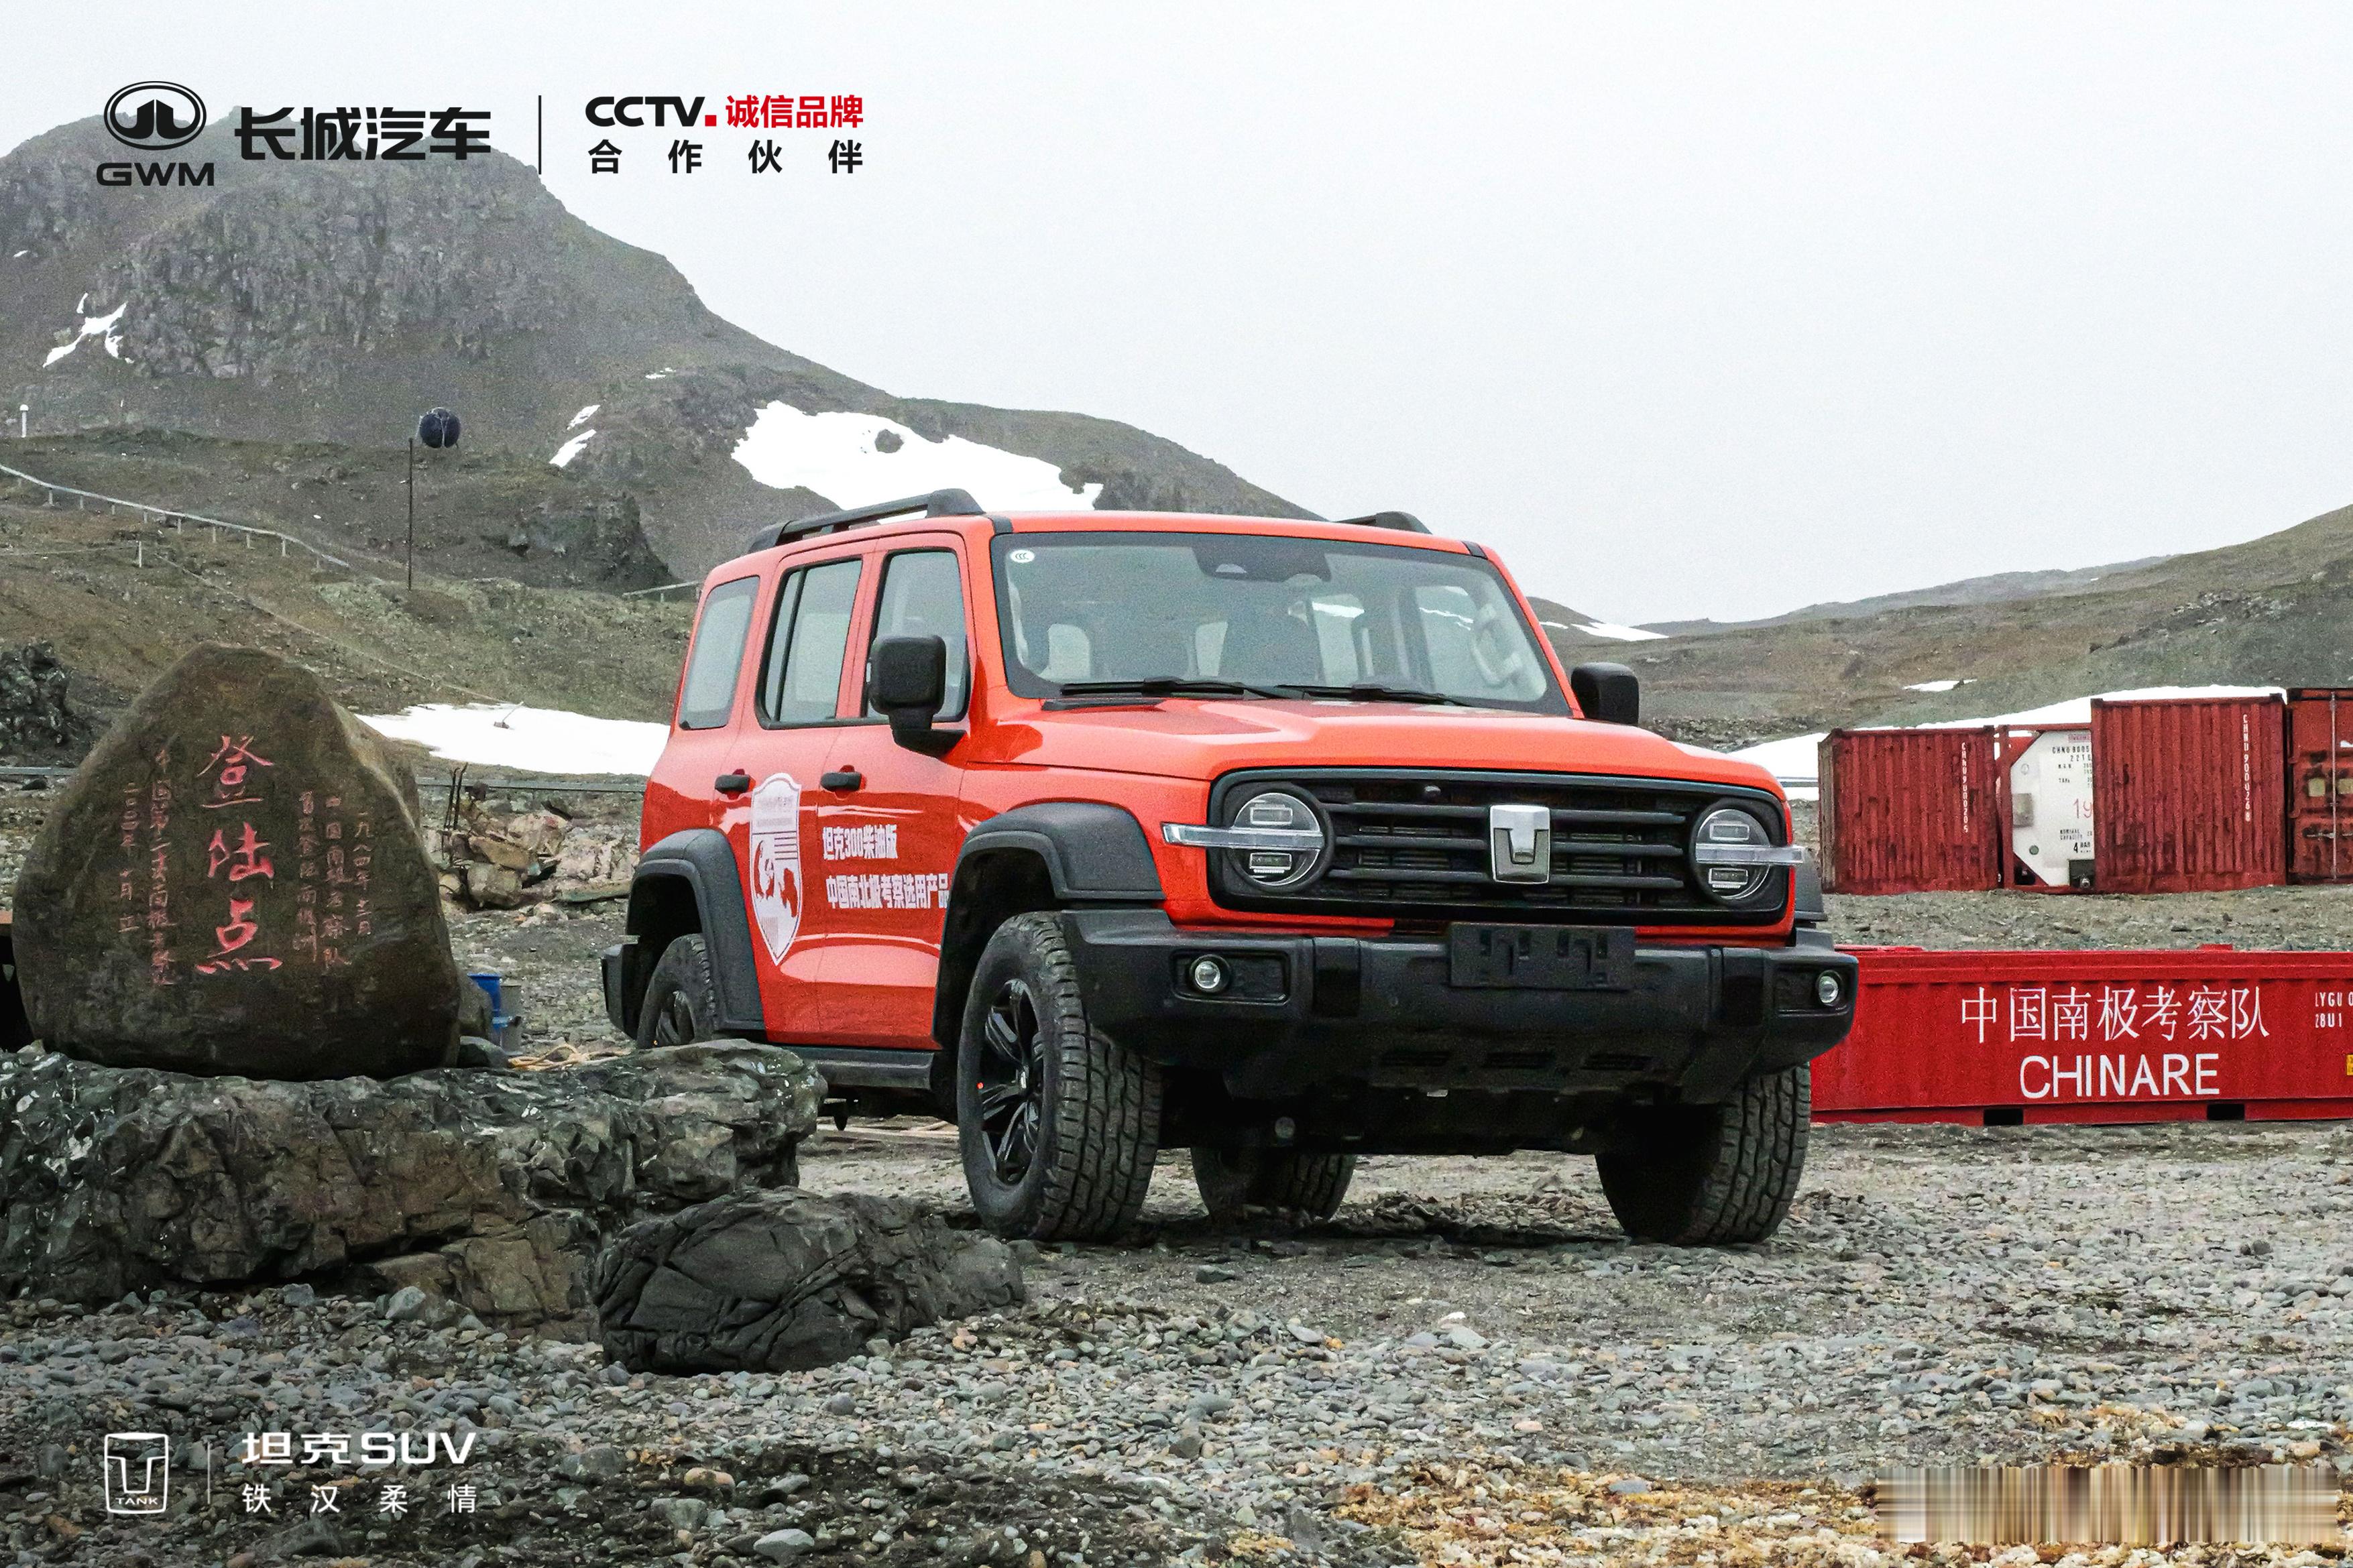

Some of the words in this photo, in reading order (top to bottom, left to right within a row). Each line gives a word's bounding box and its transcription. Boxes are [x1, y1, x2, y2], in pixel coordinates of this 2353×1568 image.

[1961, 986, 2270, 1043] 中国南极考察队
[2019, 1053, 2220, 1099] CHINARE
